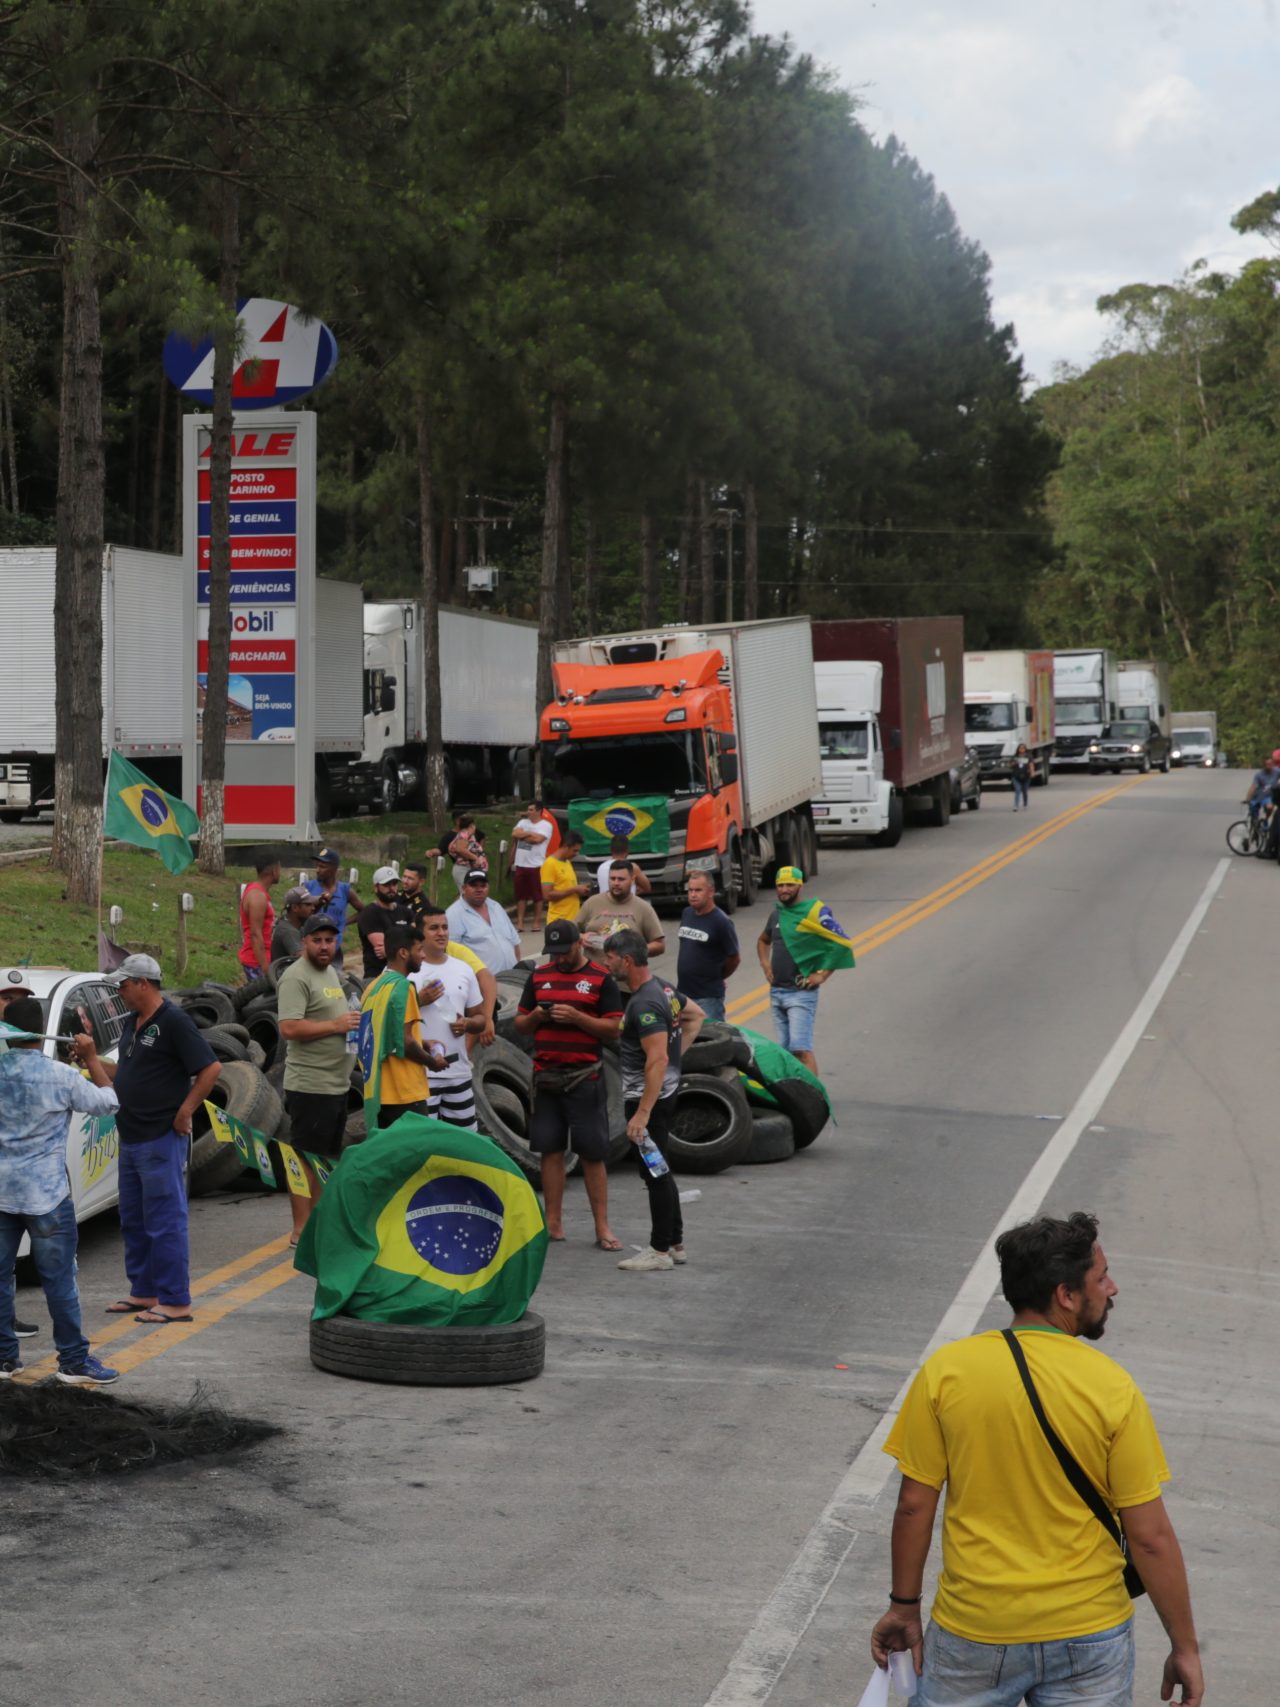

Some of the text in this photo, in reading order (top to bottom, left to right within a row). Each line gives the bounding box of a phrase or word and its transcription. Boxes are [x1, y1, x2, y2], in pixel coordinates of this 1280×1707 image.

[230, 473, 265, 483] POSTO
[229, 484, 276, 495] LARINHO
[243, 513, 281, 523] GENIAL
[231, 548, 292, 558] BEM-VINDO!
[204, 582, 291, 594] CVENIÊNCIAS
[229, 651, 287, 661] RACHARIA
[254, 694, 270, 703] SEJA
[254, 702, 292, 710] BEM-VINDO
[410, 1206, 442, 1218] ORDEM
